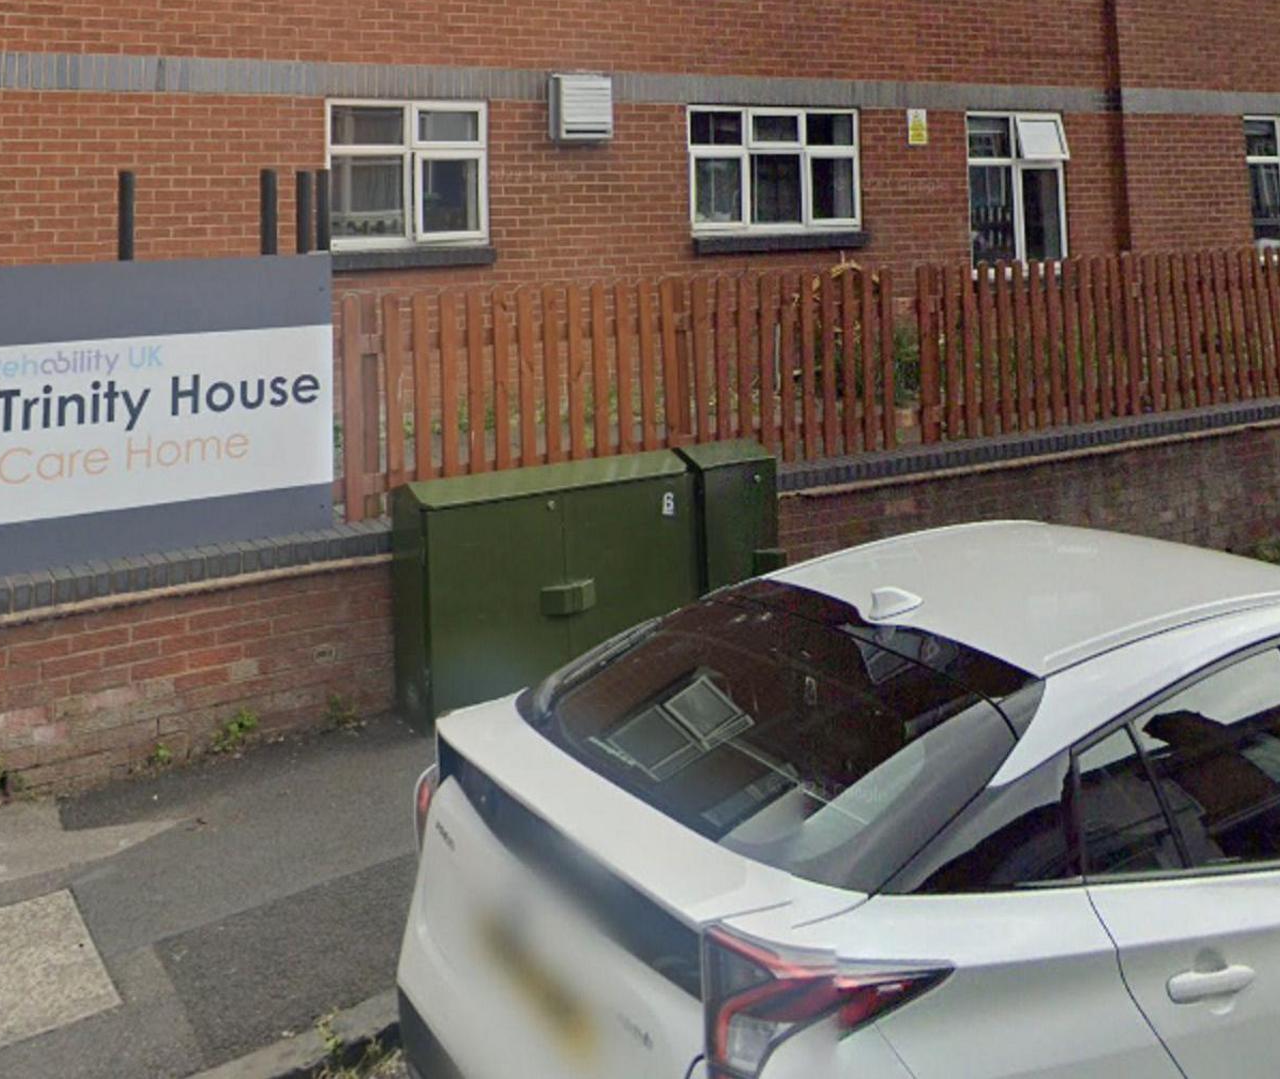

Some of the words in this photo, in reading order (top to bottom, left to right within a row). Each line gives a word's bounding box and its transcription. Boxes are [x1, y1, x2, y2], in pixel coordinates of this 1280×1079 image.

[128, 345, 163, 368] UK
[171, 374, 320, 416] House
[126, 434, 249, 470] Home
